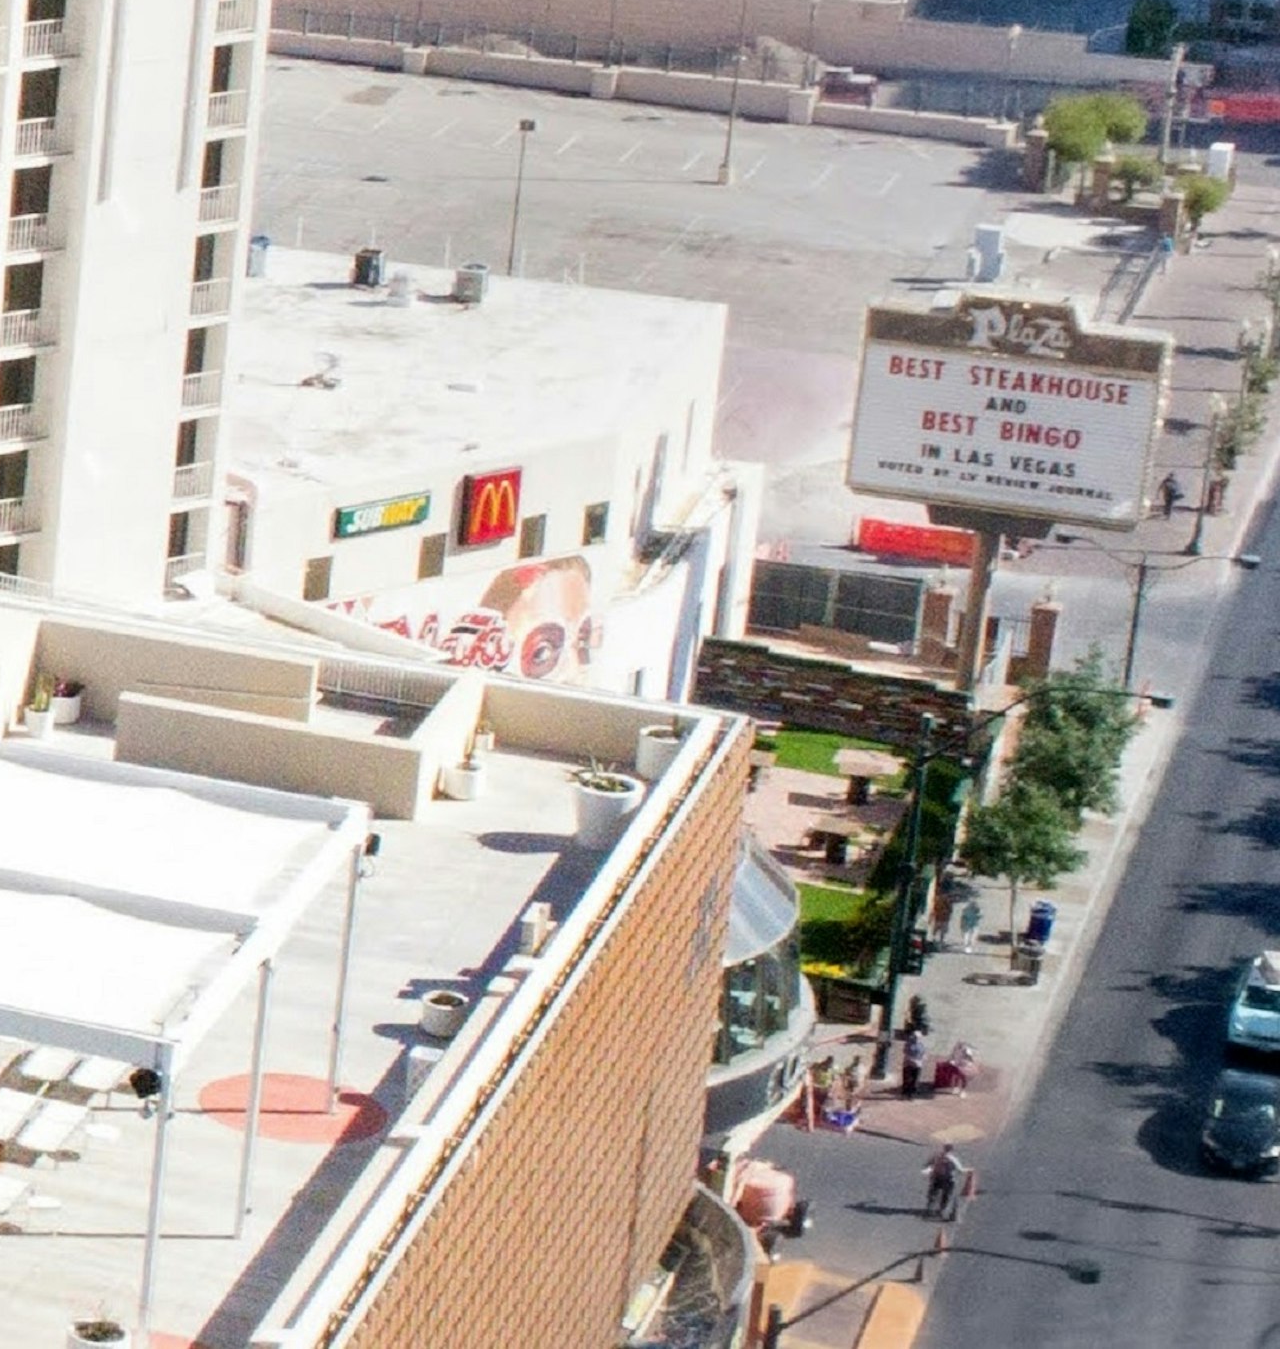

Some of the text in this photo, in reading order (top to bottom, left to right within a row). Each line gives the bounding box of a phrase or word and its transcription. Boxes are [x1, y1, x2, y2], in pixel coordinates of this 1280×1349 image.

[889, 354, 1130, 405] BEST STEAKHOUSE
[985, 397, 1028, 414] AND
[921, 409, 1082, 450] BEST BINGO
[921, 443, 1076, 477] IN LAS VEGAS
[346, 495, 427, 533] SUBWAY
